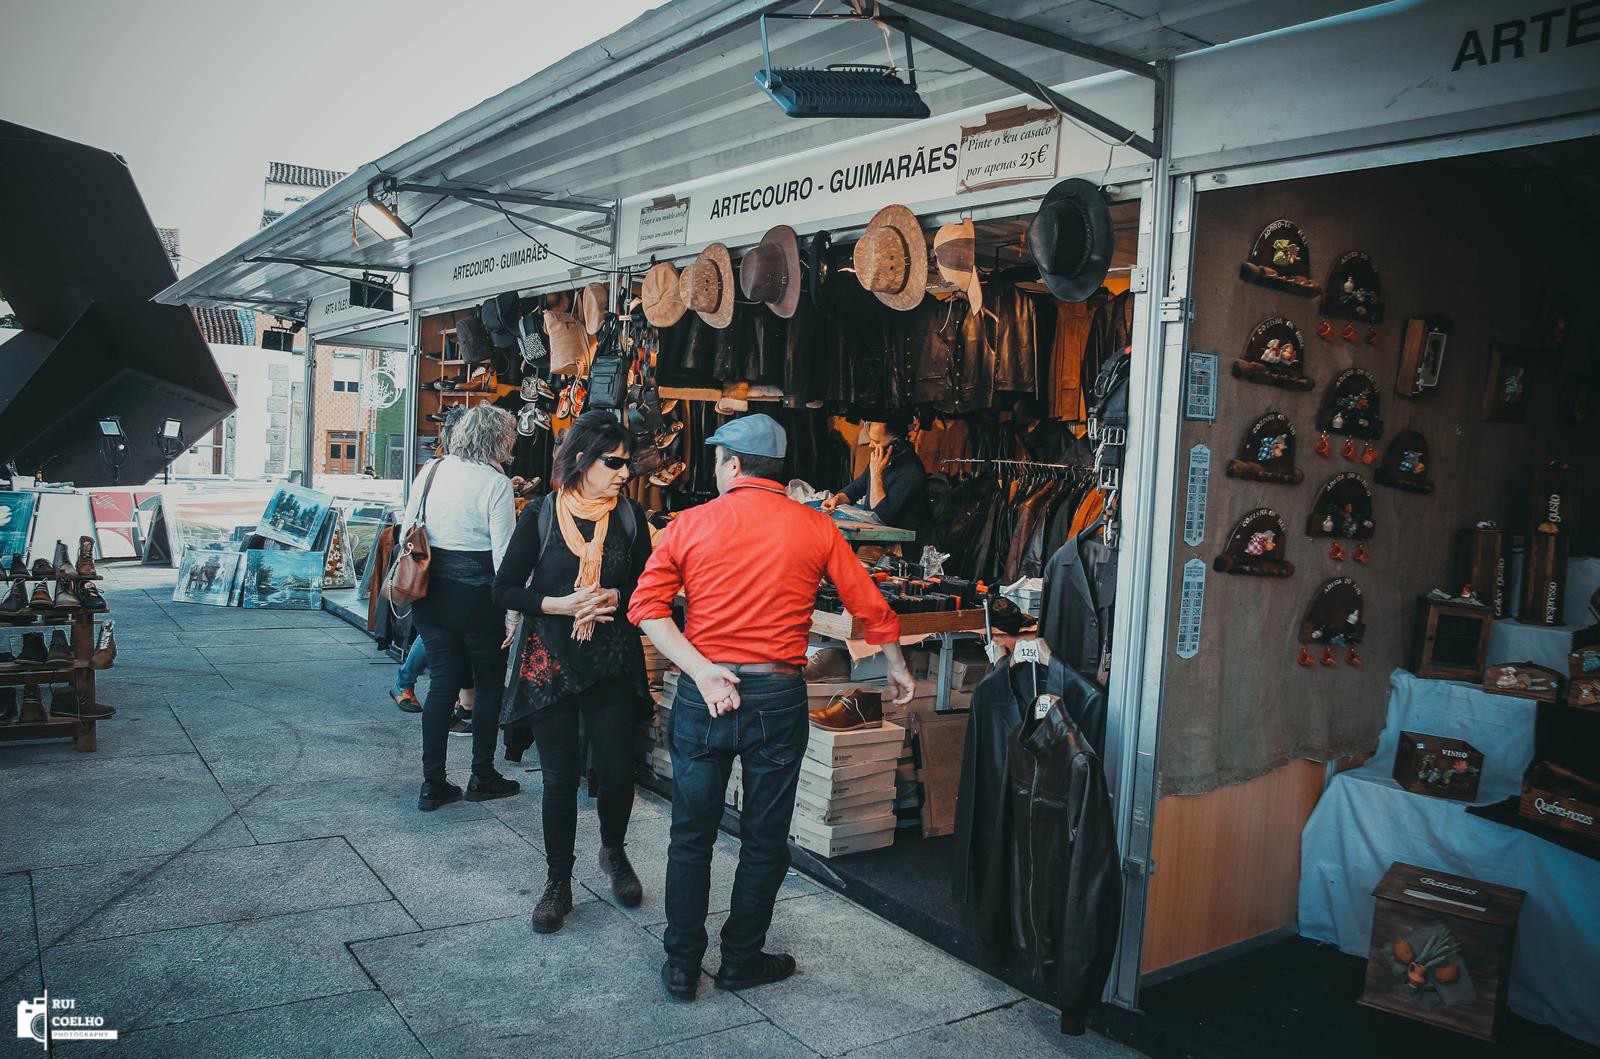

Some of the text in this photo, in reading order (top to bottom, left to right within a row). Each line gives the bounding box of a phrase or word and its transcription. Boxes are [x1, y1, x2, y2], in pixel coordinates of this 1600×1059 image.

[968, 126, 1052, 152] Pinte o seu casaco
[966, 144, 1050, 181] por apenas 25€
[710, 176, 814, 220] ARTECOURO
[829, 144, 958, 194] GUIMARÃES
[453, 257, 495, 281] ARTECOURO
[501, 243, 549, 270] GUIMARÃES
[1442, 749, 1468, 759] VINHO
